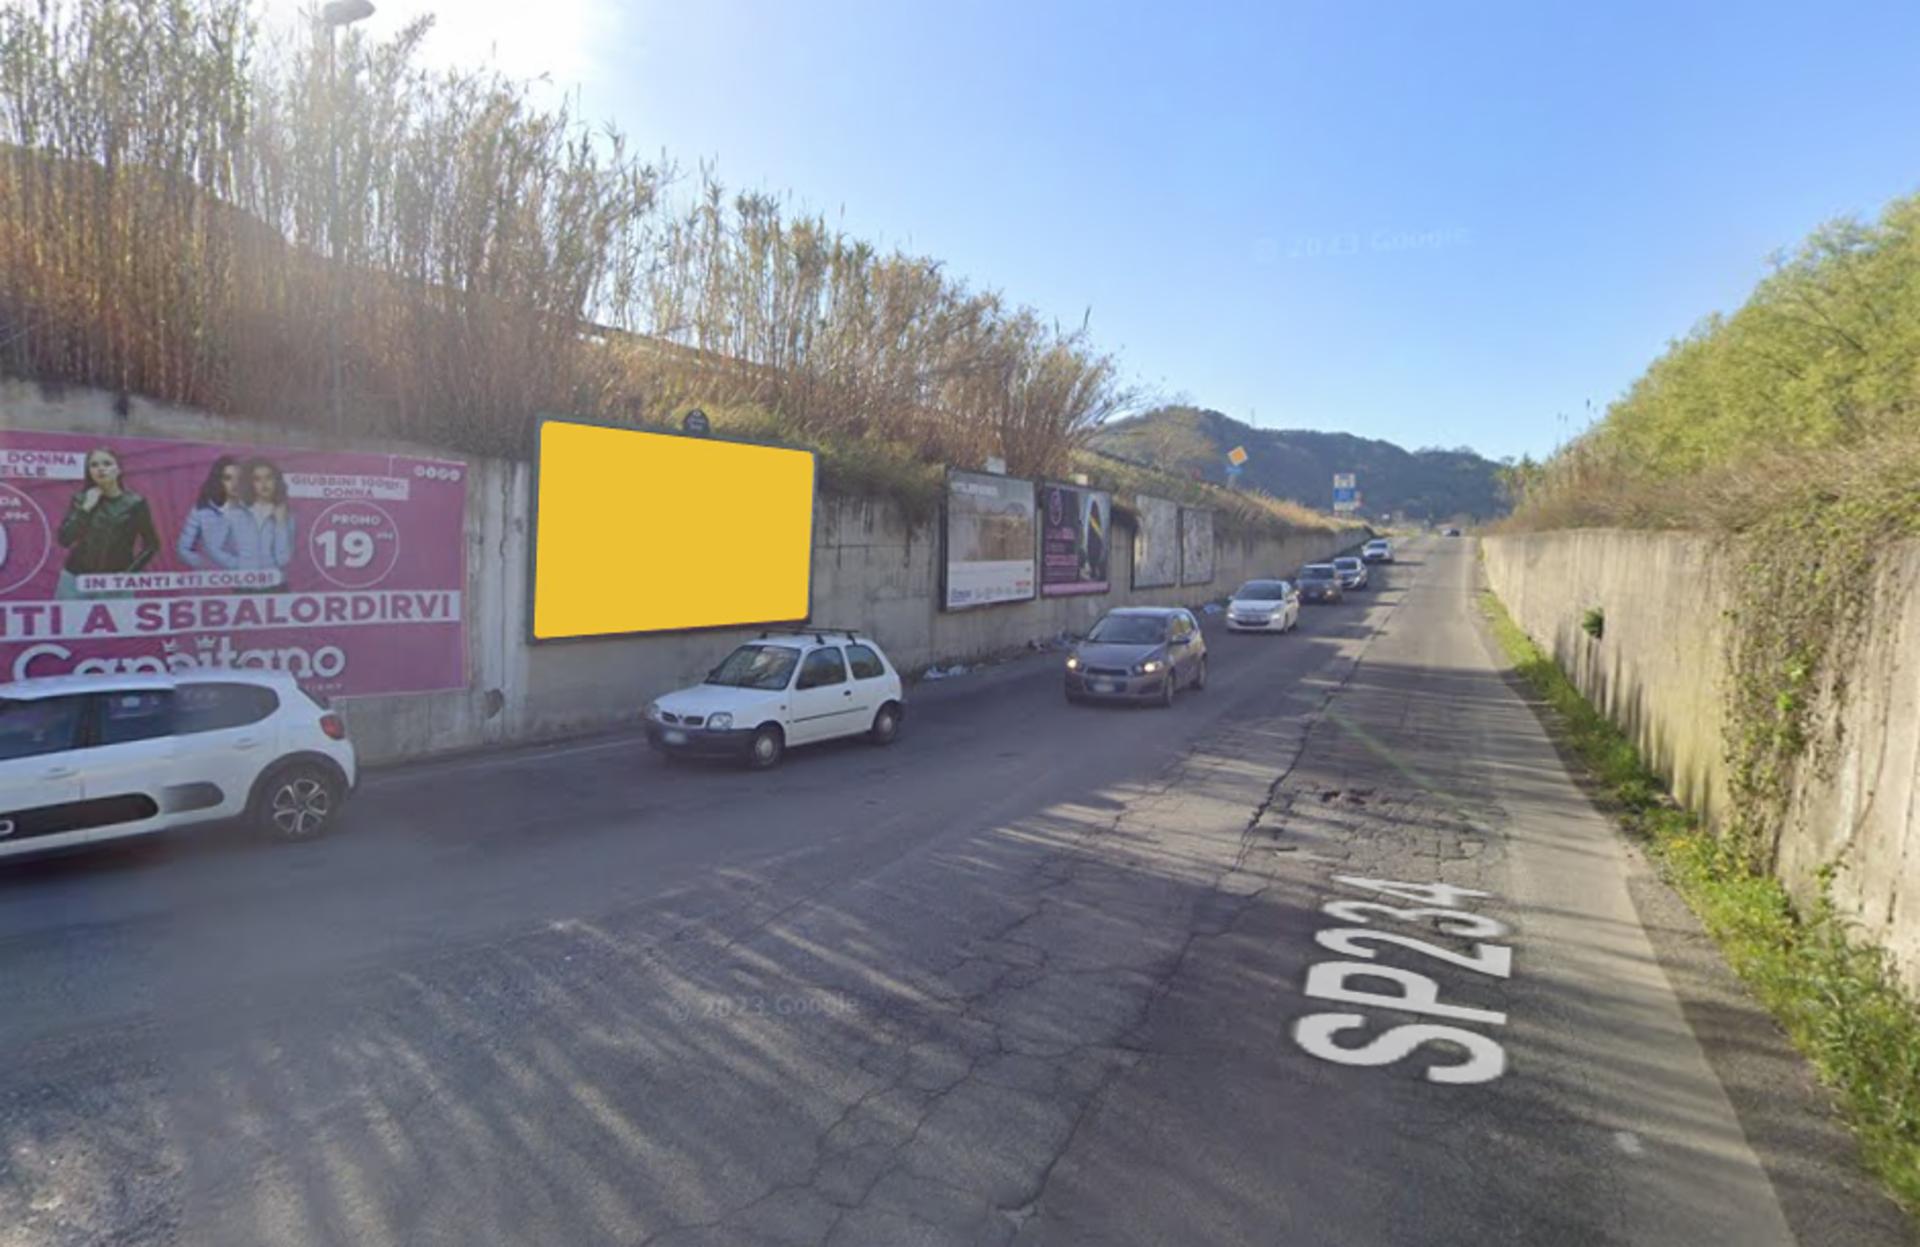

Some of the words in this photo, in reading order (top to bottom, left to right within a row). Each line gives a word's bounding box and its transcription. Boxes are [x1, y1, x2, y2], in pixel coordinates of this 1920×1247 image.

[7, 450, 77, 466] DONNA
[323, 487, 375, 497] DONNA
[331, 514, 382, 526] PROMO
[314, 529, 375, 568] 19
[85, 577, 106, 589] IN
[113, 575, 171, 589] TANTI
[208, 571, 275, 585] COLORI
[82, 603, 119, 635] A
